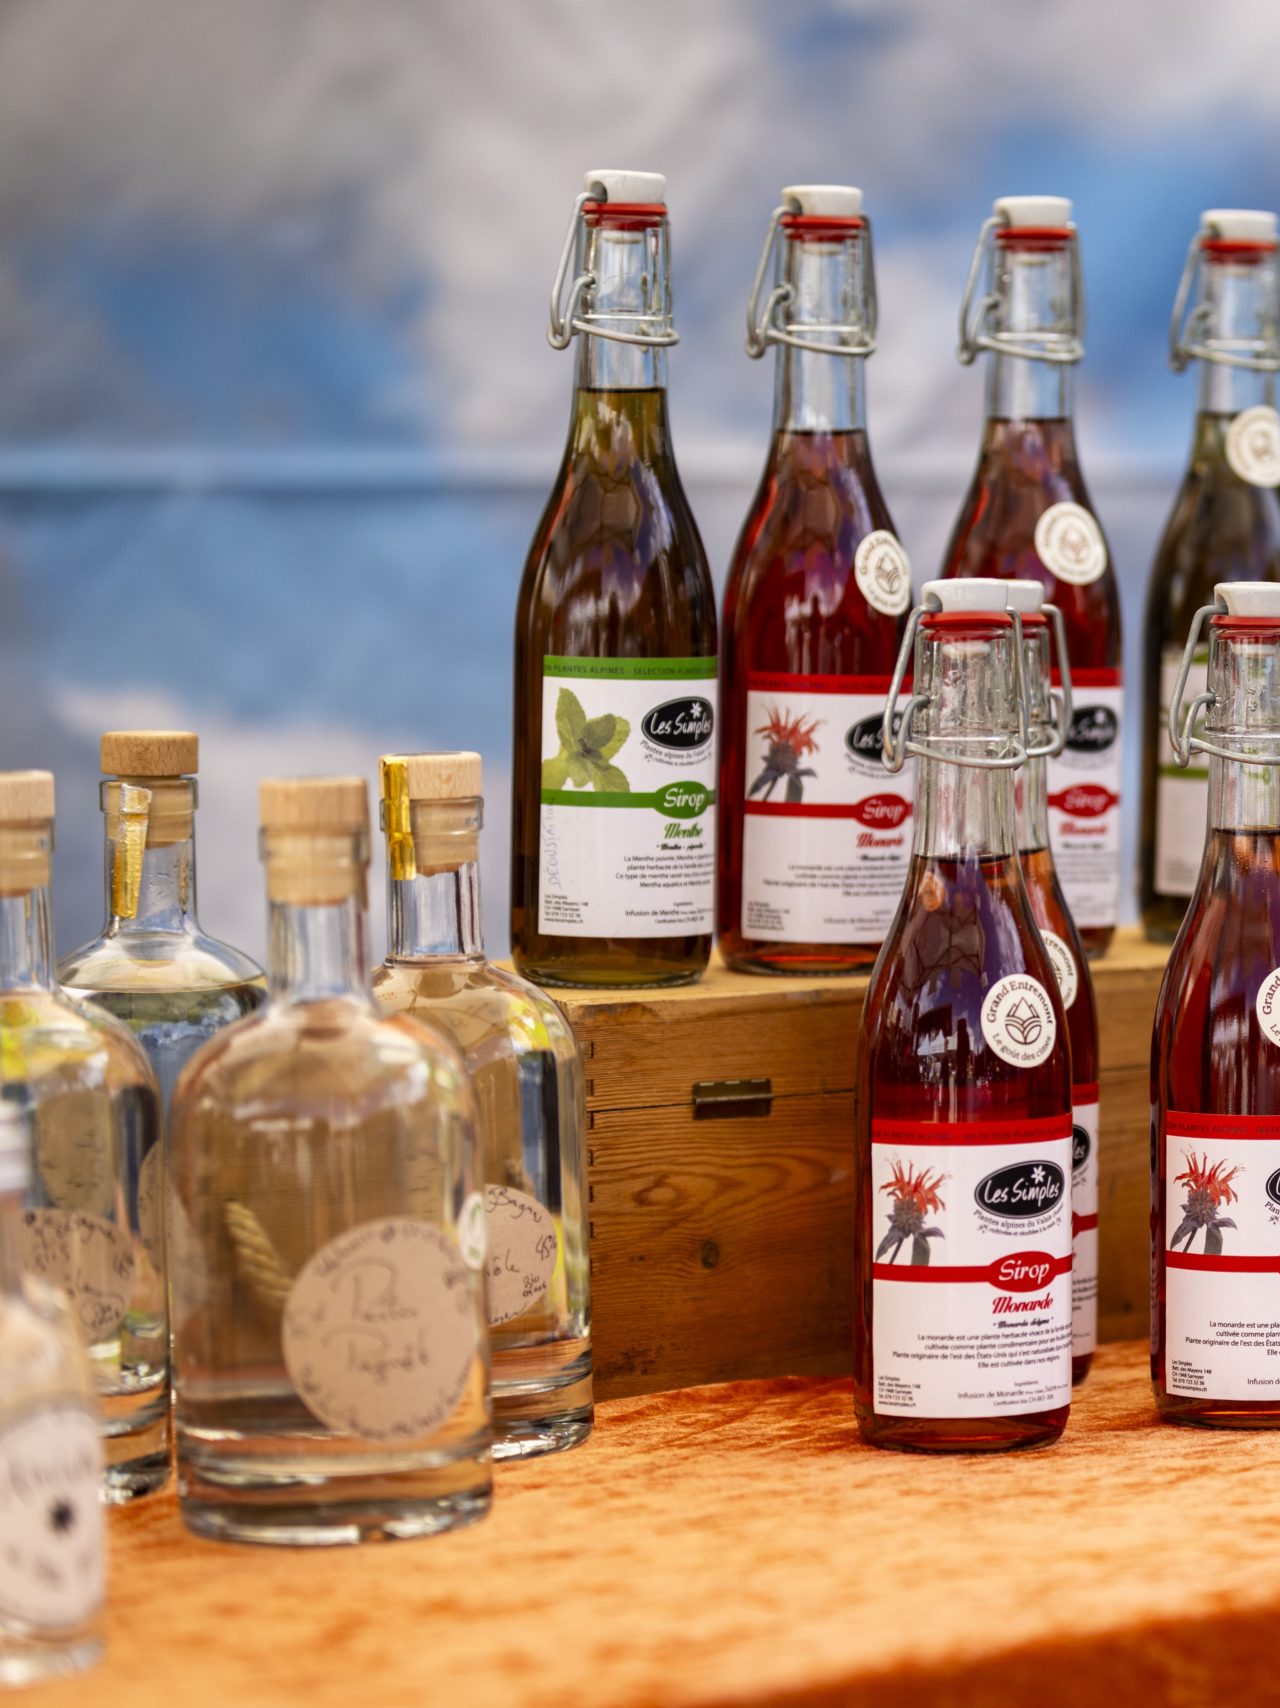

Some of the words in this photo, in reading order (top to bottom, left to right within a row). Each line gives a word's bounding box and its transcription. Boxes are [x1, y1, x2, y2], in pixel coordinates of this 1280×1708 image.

[590, 666, 624, 674] ALPINES
[650, 712, 672, 735] Les
[673, 711, 711, 741] Simples
[663, 787, 705, 813] Sirop
[861, 798, 905, 823] Sirop
[664, 822, 703, 839] Menthe
[986, 984, 1010, 1024] Grand
[1010, 980, 1053, 1024] Entremont
[1270, 1023, 1280, 1037] Le
[992, 1032, 1002, 1047] Le
[1022, 1052, 1036, 1061] des
[984, 1180, 1010, 1204] Les
[1011, 1175, 1060, 1208] Simples
[973, 1209, 1000, 1226] Plantes
[998, 1259, 1050, 1285] Sirop
[992, 1293, 1054, 1314] Monarde
[1209, 1320, 1216, 1328] La
[980, 1332, 1000, 1341] plante
[1185, 1336, 1202, 1344] Plante
[1202, 1338, 1230, 1346] originaire
[976, 1342, 996, 1350] plante
[958, 1390, 986, 1400] Infusion
[986, 1390, 996, 1398] de
[996, 1388, 1024, 1398] Monarde
